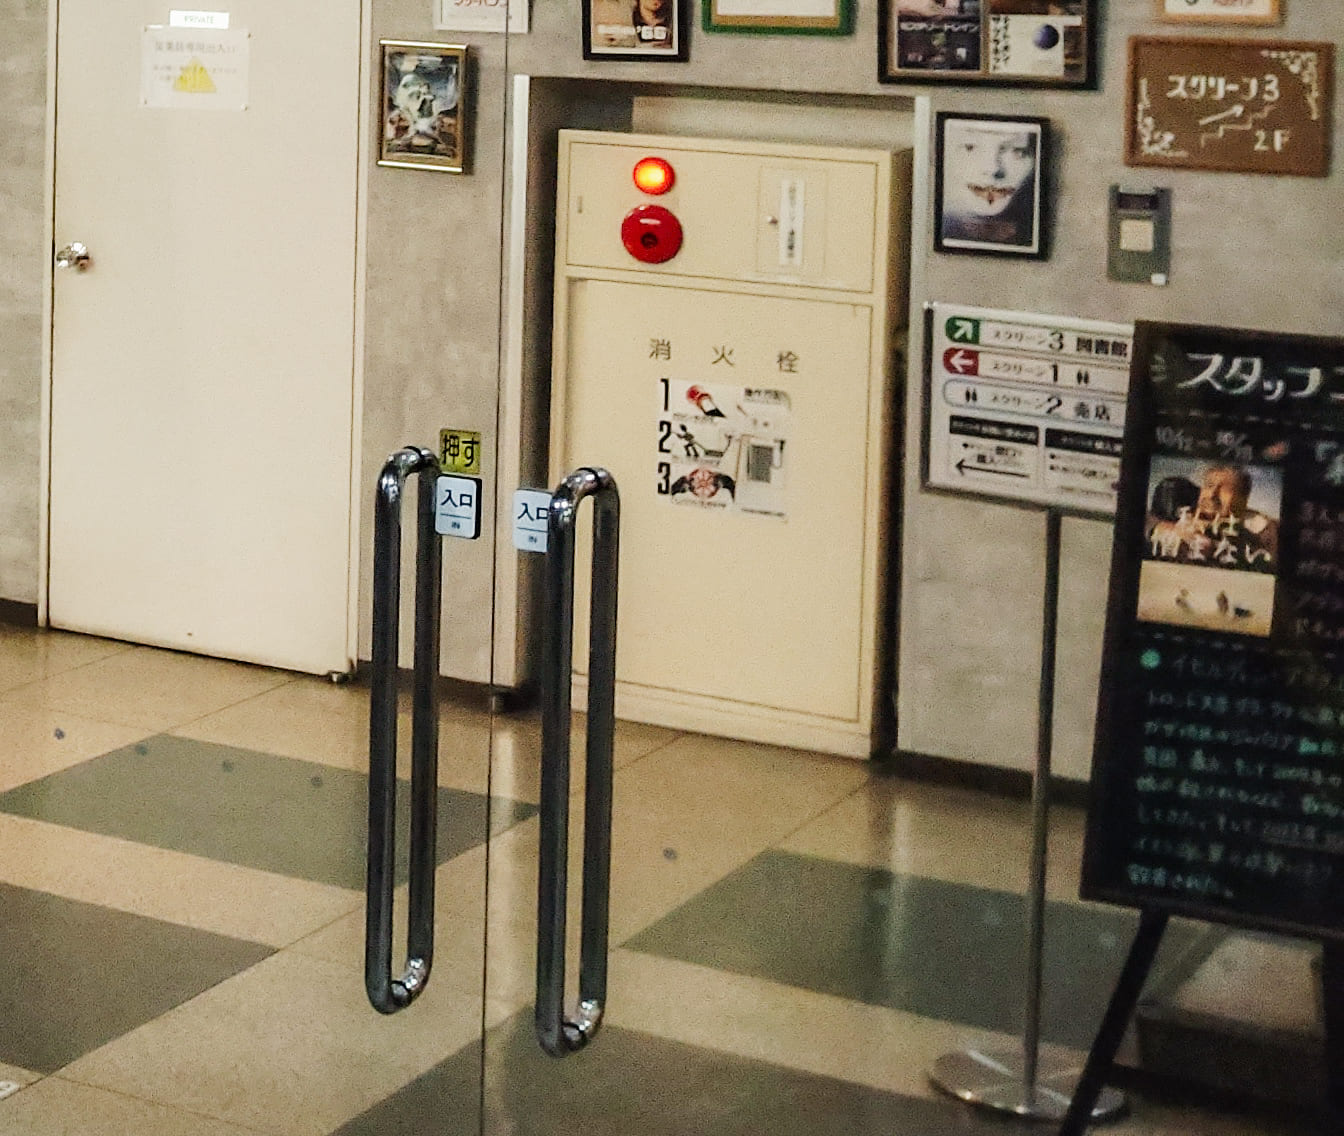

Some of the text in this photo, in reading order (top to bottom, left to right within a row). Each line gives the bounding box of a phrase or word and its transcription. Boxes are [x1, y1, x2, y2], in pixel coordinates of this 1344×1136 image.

[649, 338, 801, 375] 消火栓
[660, 378, 670, 412] 1
[442, 434, 480, 467] 押す
[658, 420, 672, 453] 2
[657, 462, 671, 495] 3
[440, 489, 473, 508] 入口
[517, 502, 549, 522] 入口
